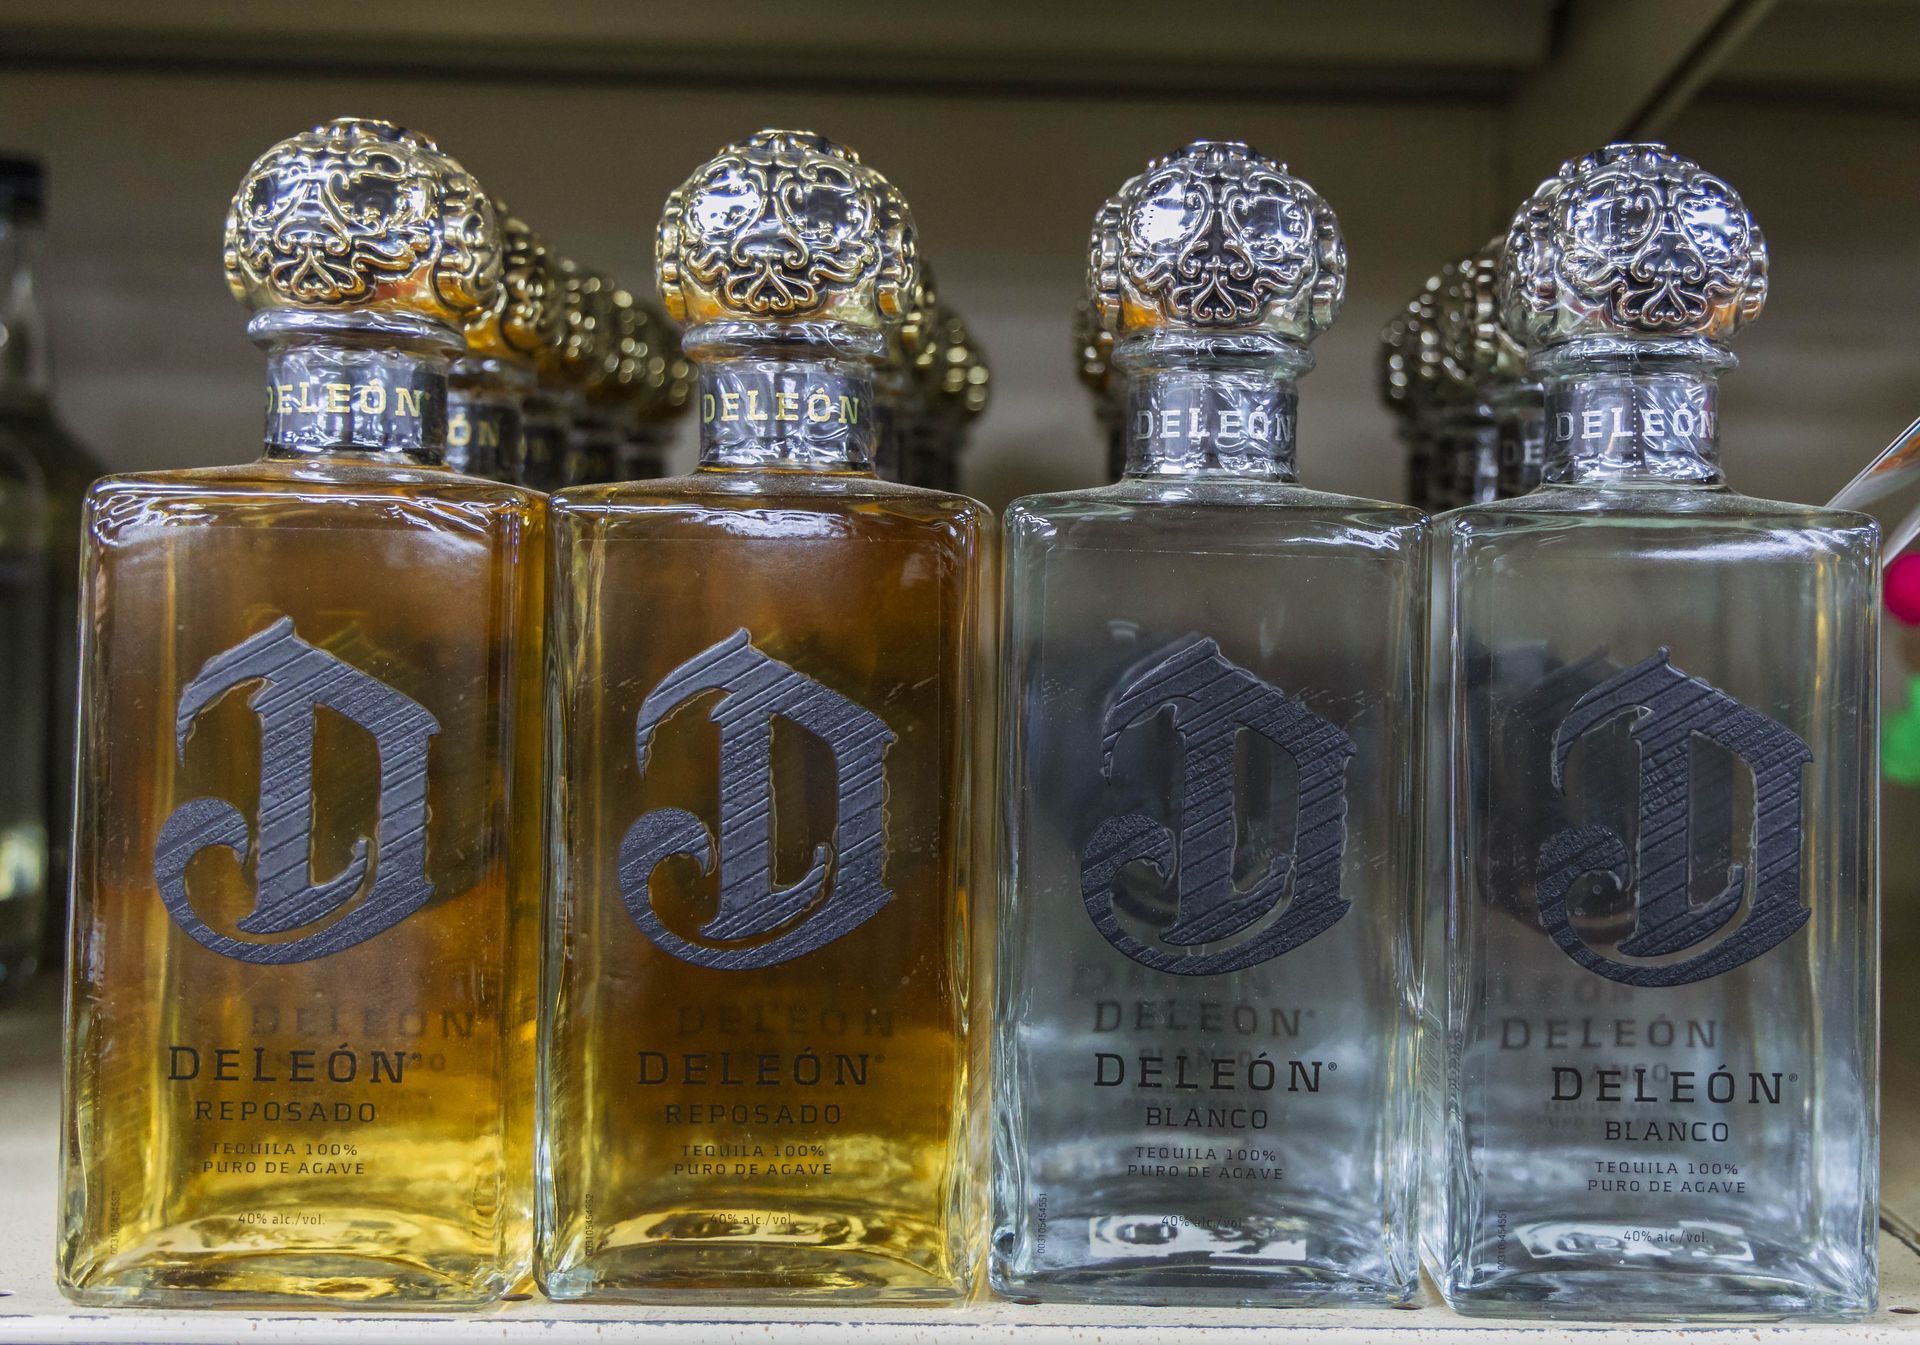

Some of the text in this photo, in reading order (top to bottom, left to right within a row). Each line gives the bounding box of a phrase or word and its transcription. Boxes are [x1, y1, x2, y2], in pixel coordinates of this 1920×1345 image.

[703, 387, 859, 425] DELEÓN
[1136, 404, 1294, 442] DELEÓN
[1555, 402, 1715, 441] DELEÓN
[195, 1100, 377, 1123] REPOSADO
[665, 1103, 842, 1125] REPOSADO
[1145, 1106, 1269, 1130] BLANCO
[1604, 1120, 1730, 1143] BLANCO
[211, 1142, 358, 1156] TEQUILA 100%
[680, 1144, 825, 1157] TEQUILA 100%
[1135, 1146, 1276, 1162] TEQUILA 100%
[202, 1161, 365, 1175] PURO DE AGAVE
[673, 1163, 833, 1175] PURO DE AGAVE
[1127, 1164, 1283, 1180] PURO DE AGAVE
[1594, 1161, 1739, 1175] TEQUILA 100%
[1587, 1179, 1746, 1193] PURO DE AGAVE
[238, 1212, 268, 1225] 40%
[710, 1213, 739, 1226] 40%
[1161, 1215, 1190, 1228] 40%
[1623, 1230, 1652, 1242] 40%
